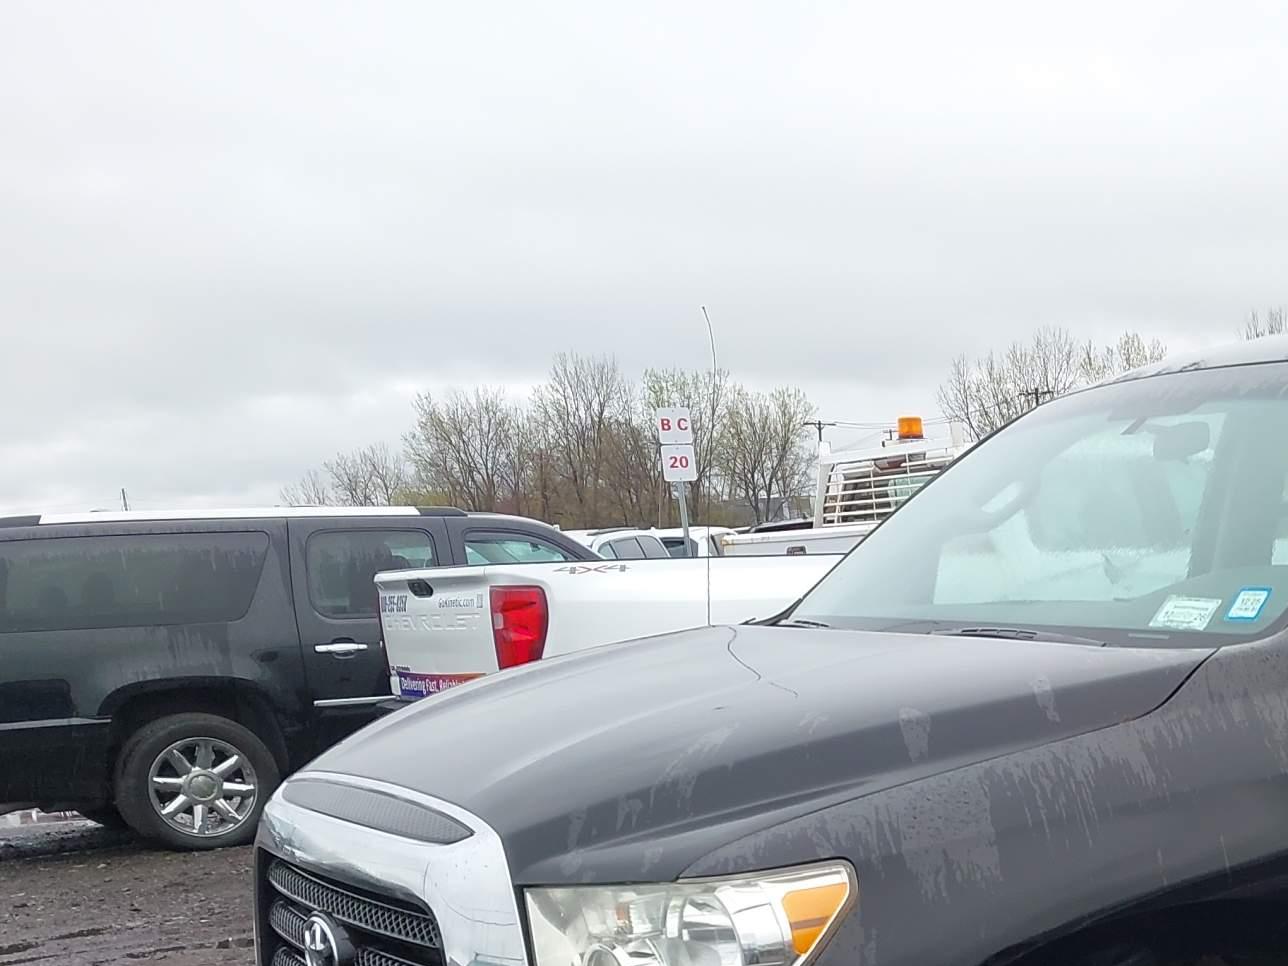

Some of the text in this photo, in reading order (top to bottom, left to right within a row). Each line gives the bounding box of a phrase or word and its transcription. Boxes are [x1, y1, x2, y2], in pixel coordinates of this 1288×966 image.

[669, 456, 689, 469] 20
[384, 612, 481, 632] CHEVROLET
[401, 677, 427, 695] Delivering
